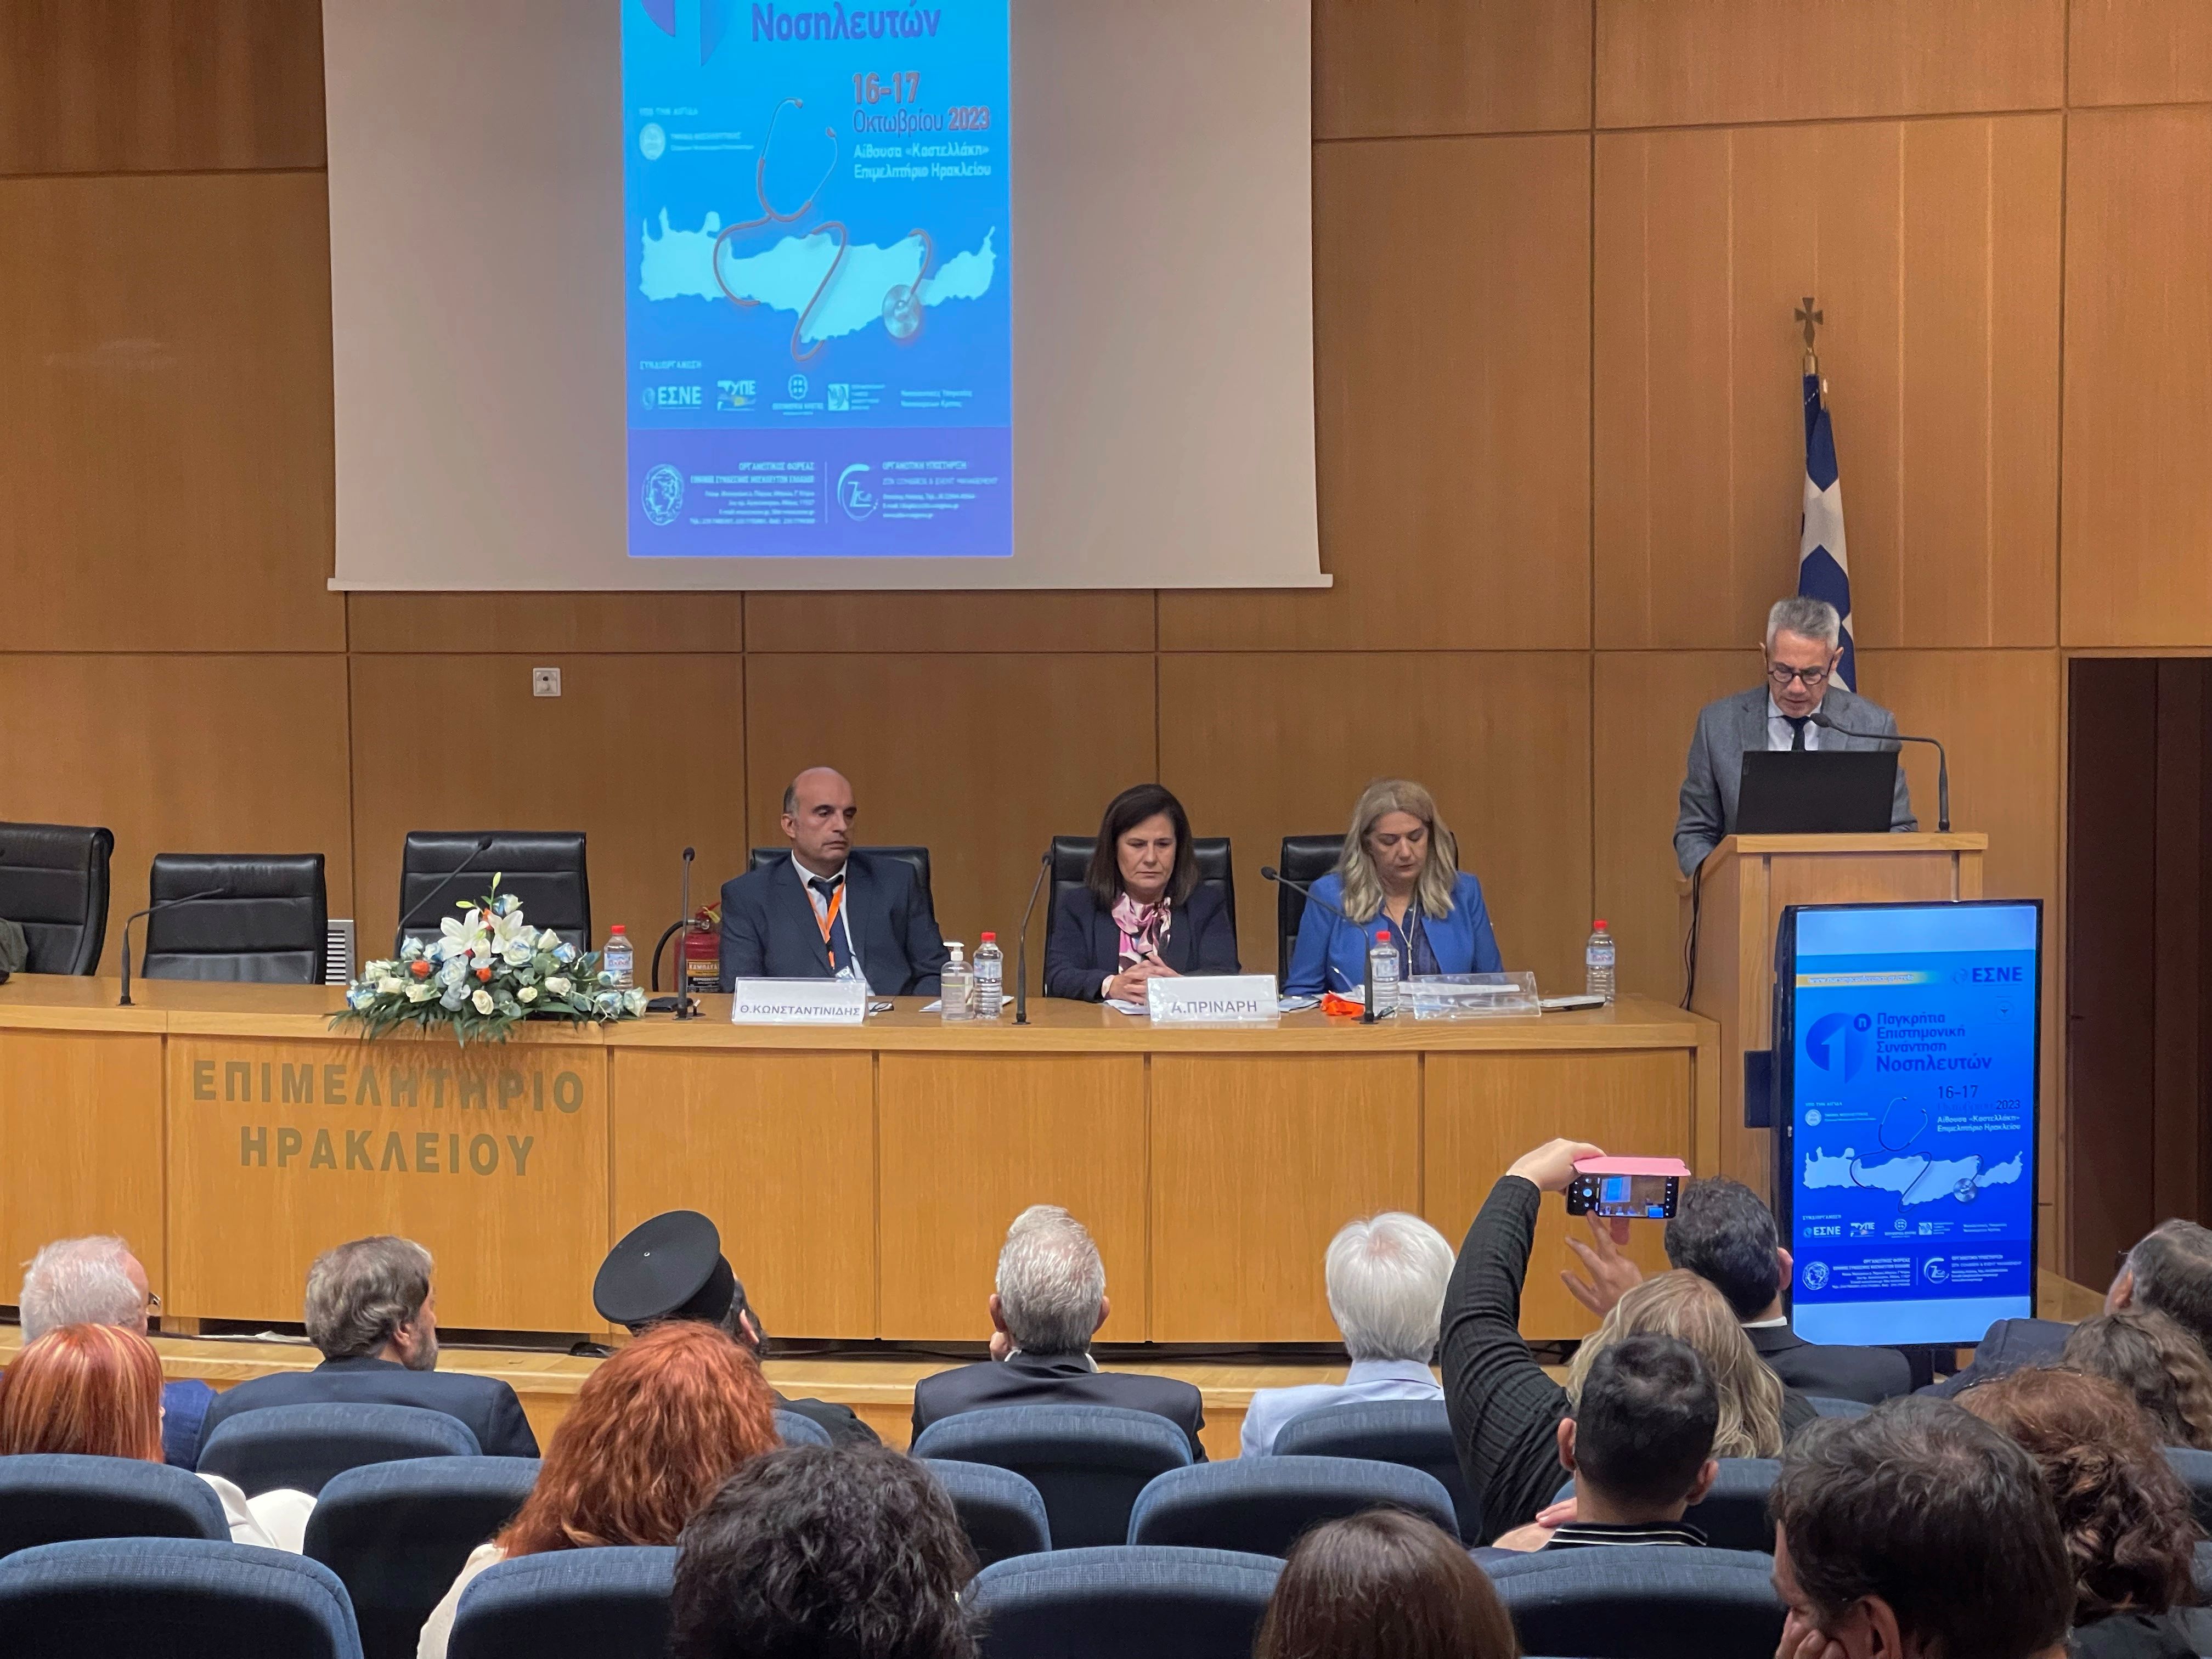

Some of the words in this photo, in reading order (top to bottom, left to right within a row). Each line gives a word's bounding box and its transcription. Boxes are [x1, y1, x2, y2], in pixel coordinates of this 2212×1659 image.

[752, 0, 941, 42] Νοσηλευτών
[854, 108, 943, 138] Οκτωβρίου
[949, 106, 990, 131] 2023
[854, 144, 902, 158] Αίθουσα
[658, 386, 702, 405] ΕΣΝΕ
[1972, 967, 2023, 983] ΕΣΝΕ
[740, 1005, 860, 1015] Θ.ΚΩΝΣΤΑΝΤΙΝΙΔΗΣ
[1171, 1000, 1257, 1013] Α.ΠΡΙΝΑΡΗ
[1877, 1012, 1945, 1027] Παγκρήτια
[1877, 1024, 1965, 1041] Επιστημονική
[1876, 1041, 1946, 1053] Συνάντηση
[1876, 1053, 1992, 1072] Νοσηλευτών
[193, 1060, 584, 1114] ΕΠΙΜΕΛΗΤΗΡΙΟ
[1996, 1099, 2021, 1109] 2023
[240, 1126, 535, 1176] ΗΡΑΚΛΕΙΟΥ
[1813, 1226, 1841, 1236] ΕΣΝΕ
